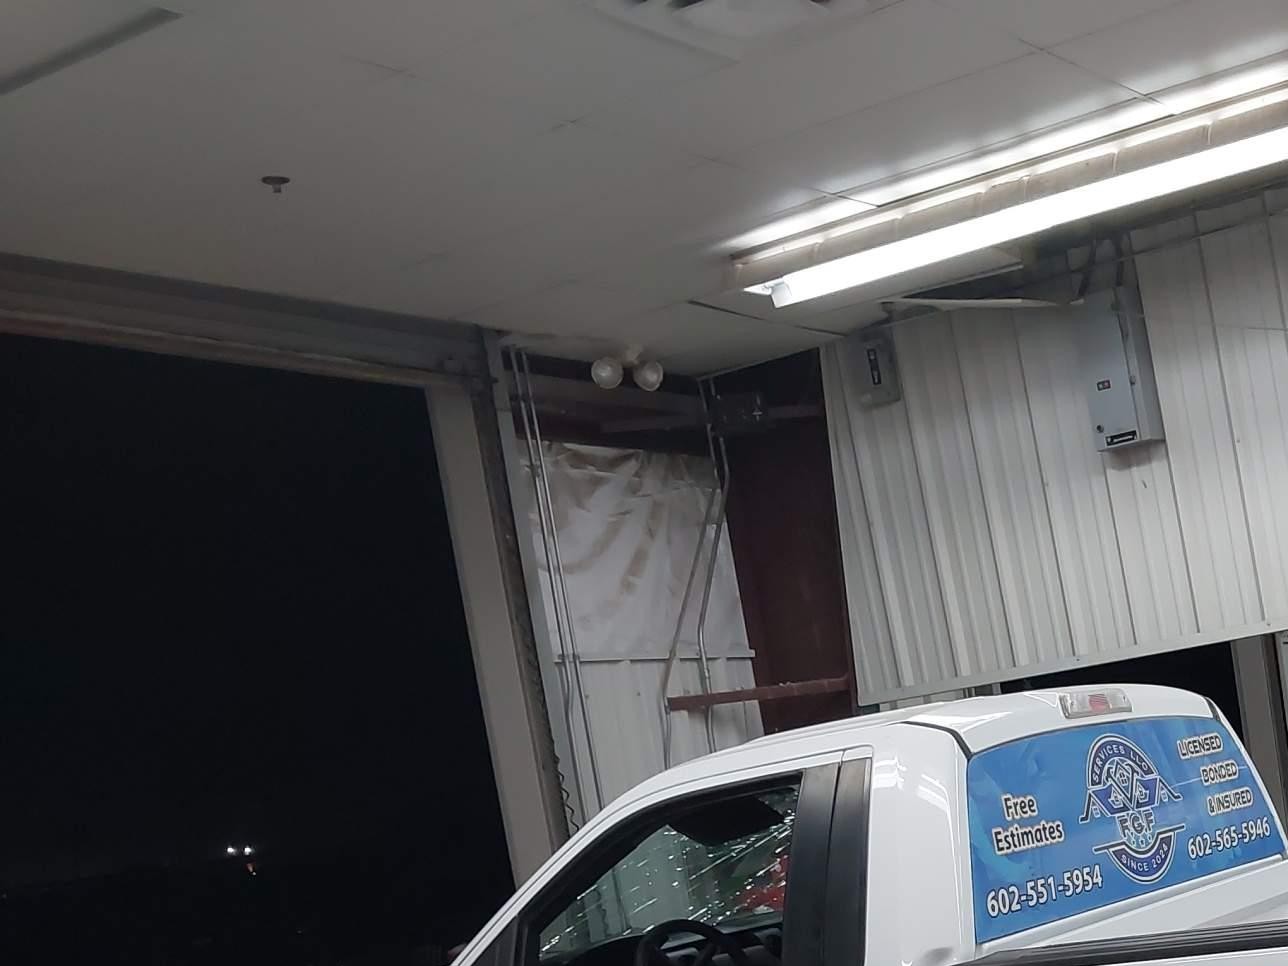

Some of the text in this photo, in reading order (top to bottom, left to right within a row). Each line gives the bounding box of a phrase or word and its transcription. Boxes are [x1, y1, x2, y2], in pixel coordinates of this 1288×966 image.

[1179, 734, 1222, 757] LICENSED
[1092, 744, 1125, 783] SERVICES
[1202, 762, 1238, 784] BONDED
[1004, 793, 1037, 818] Free
[1208, 789, 1252, 813] & INSURED
[994, 824, 1063, 851] Estimates
[1187, 817, 1271, 859] 602-565-5946
[1121, 842, 1169, 872] SINCE 2024
[986, 864, 1103, 917] 602-551-5954
